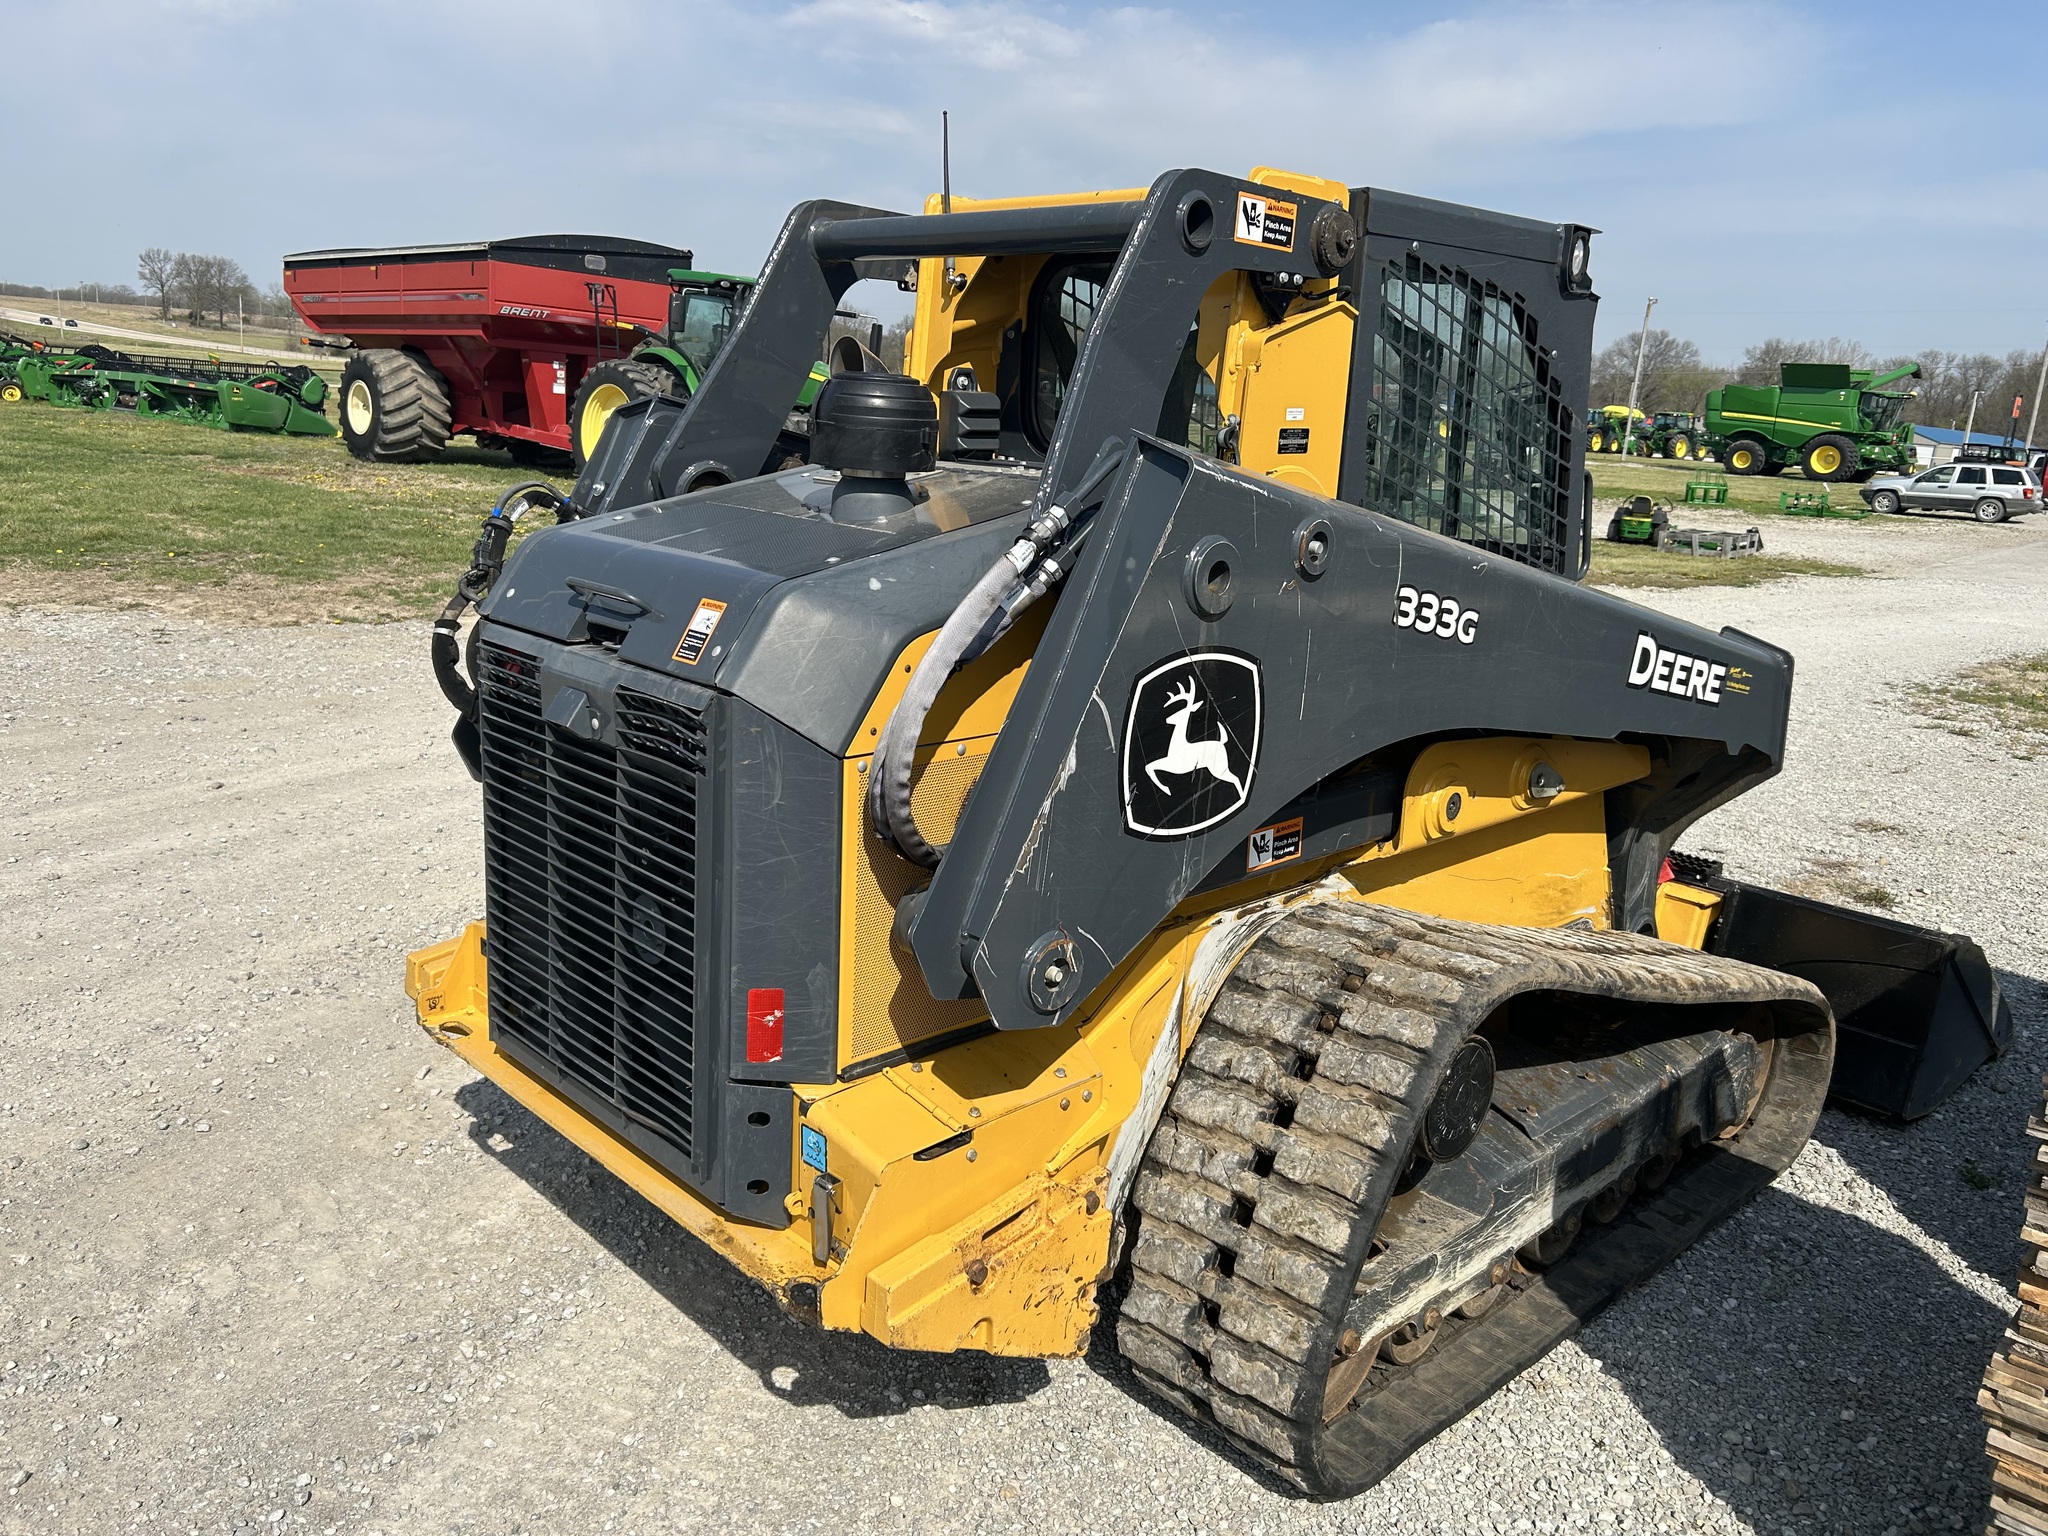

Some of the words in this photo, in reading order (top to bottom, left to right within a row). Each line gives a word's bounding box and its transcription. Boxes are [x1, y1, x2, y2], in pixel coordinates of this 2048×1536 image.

[1272, 205, 1294, 215] WARNING
[1265, 220, 1279, 230] Pinch
[1280, 224, 1292, 232] Area
[1264, 230, 1276, 240] Keep
[1276, 233, 1287, 242] Away
[499, 305, 551, 319] BRENT
[1393, 586, 1480, 644] 333G
[1627, 633, 1727, 704] DEERE
[1280, 822, 1300, 830] WARNING
[1274, 839, 1287, 848] Pinch
[1288, 836, 1299, 844] Area
[1284, 845, 1295, 853] Away
